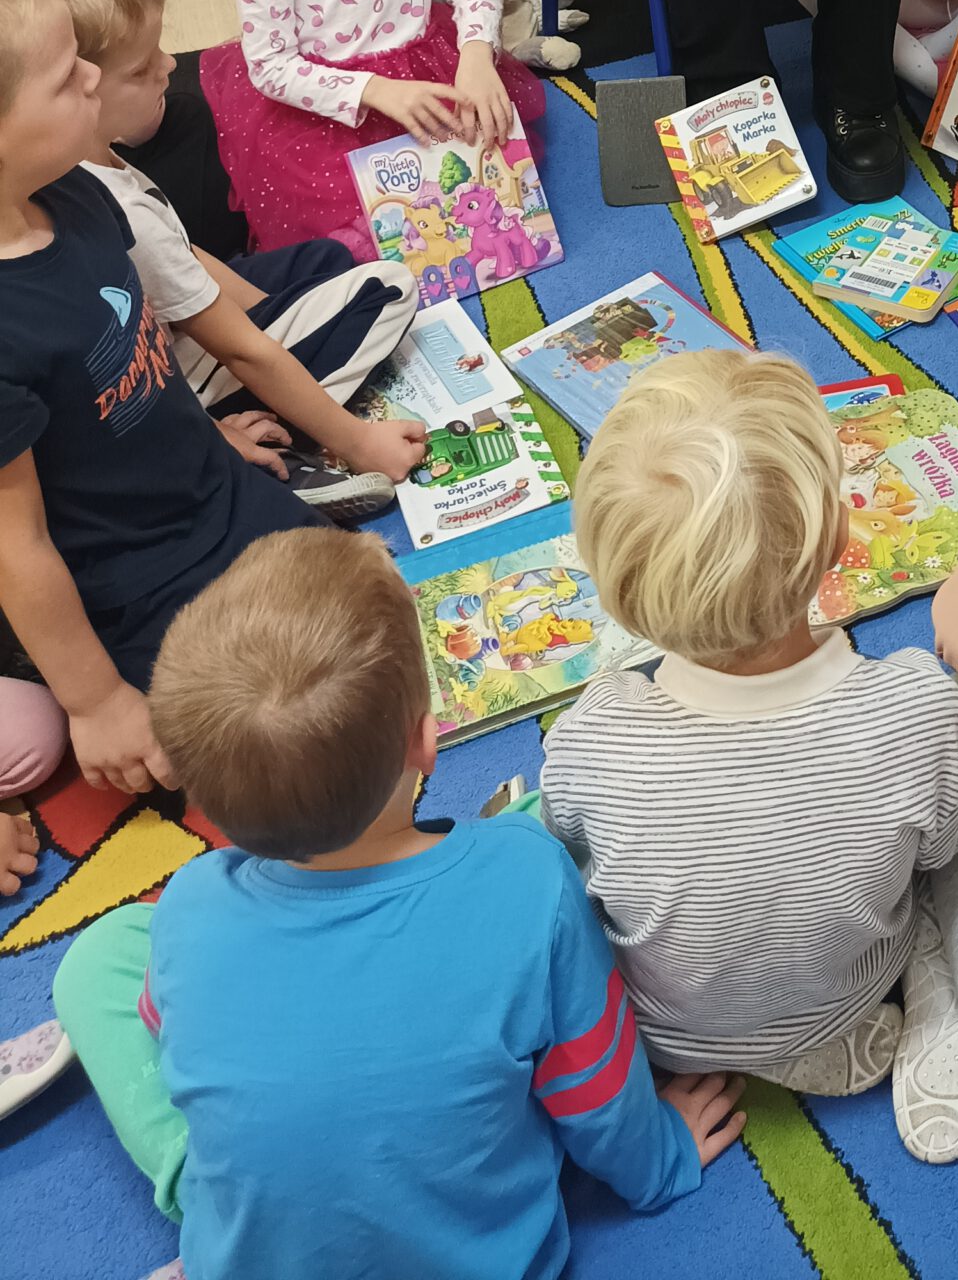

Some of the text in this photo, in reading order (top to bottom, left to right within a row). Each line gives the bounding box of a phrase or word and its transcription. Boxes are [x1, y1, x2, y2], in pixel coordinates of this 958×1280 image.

[715, 95, 753, 116] chłopiec
[733, 111, 777, 134] Koparka
[742, 125, 777, 142] Marka
[374, 158, 387, 169] my
[389, 158, 416, 175] little
[376, 166, 421, 193] Pony
[911, 449, 955, 499] wróżka
[433, 480, 507, 510] Śmieciarka
[447, 478, 487, 496] Jarka
[445, 506, 493, 524] chłopiec
